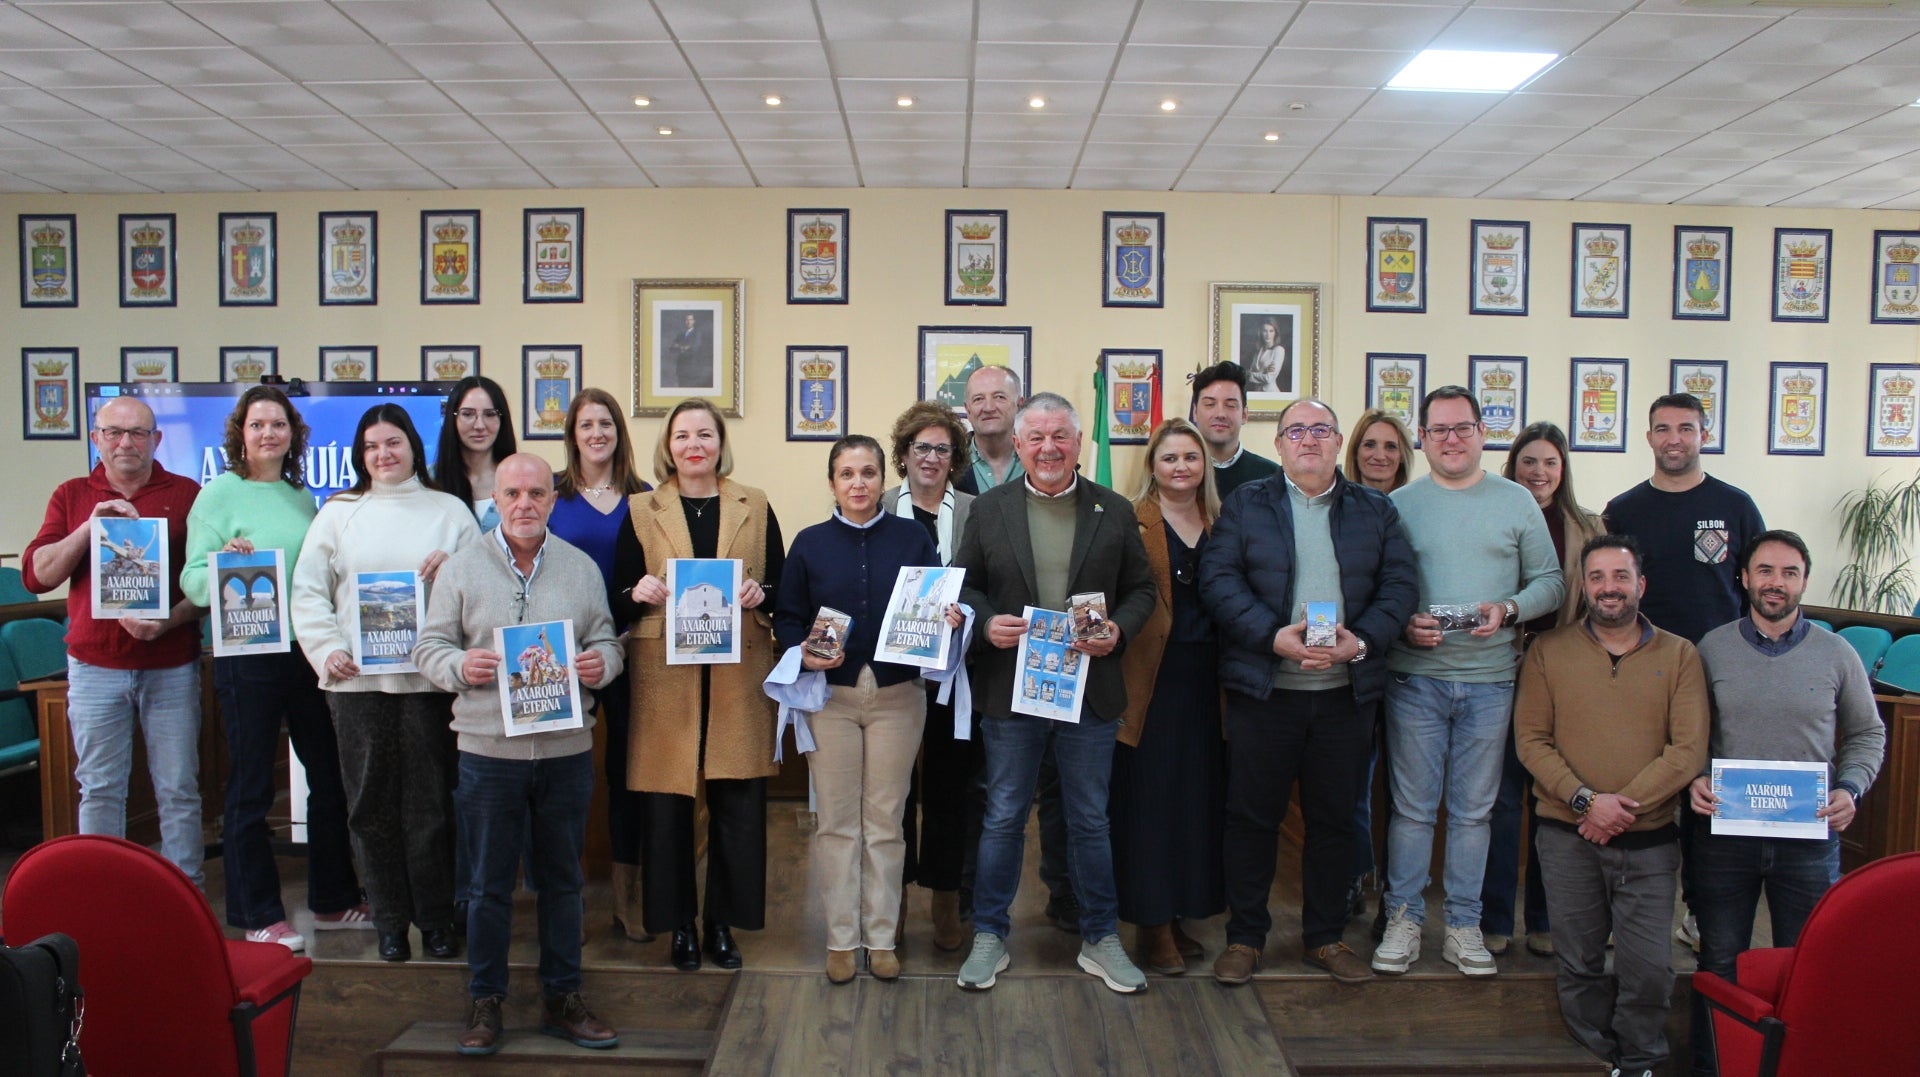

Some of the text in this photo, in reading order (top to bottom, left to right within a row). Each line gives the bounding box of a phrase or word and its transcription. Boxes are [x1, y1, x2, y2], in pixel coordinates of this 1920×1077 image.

[1697, 520, 1725, 529] SILBON
[113, 589, 149, 600] ETERNA
[233, 623, 270, 636] ETERNA
[686, 633, 722, 645] ETERNA
[896, 633, 930, 648] ETERNA
[373, 643, 408, 655] ETERNA
[523, 698, 561, 714] ETERNA
[1745, 783, 1793, 797] AXARQUÍA
[1751, 797, 1788, 809] ETERNA
